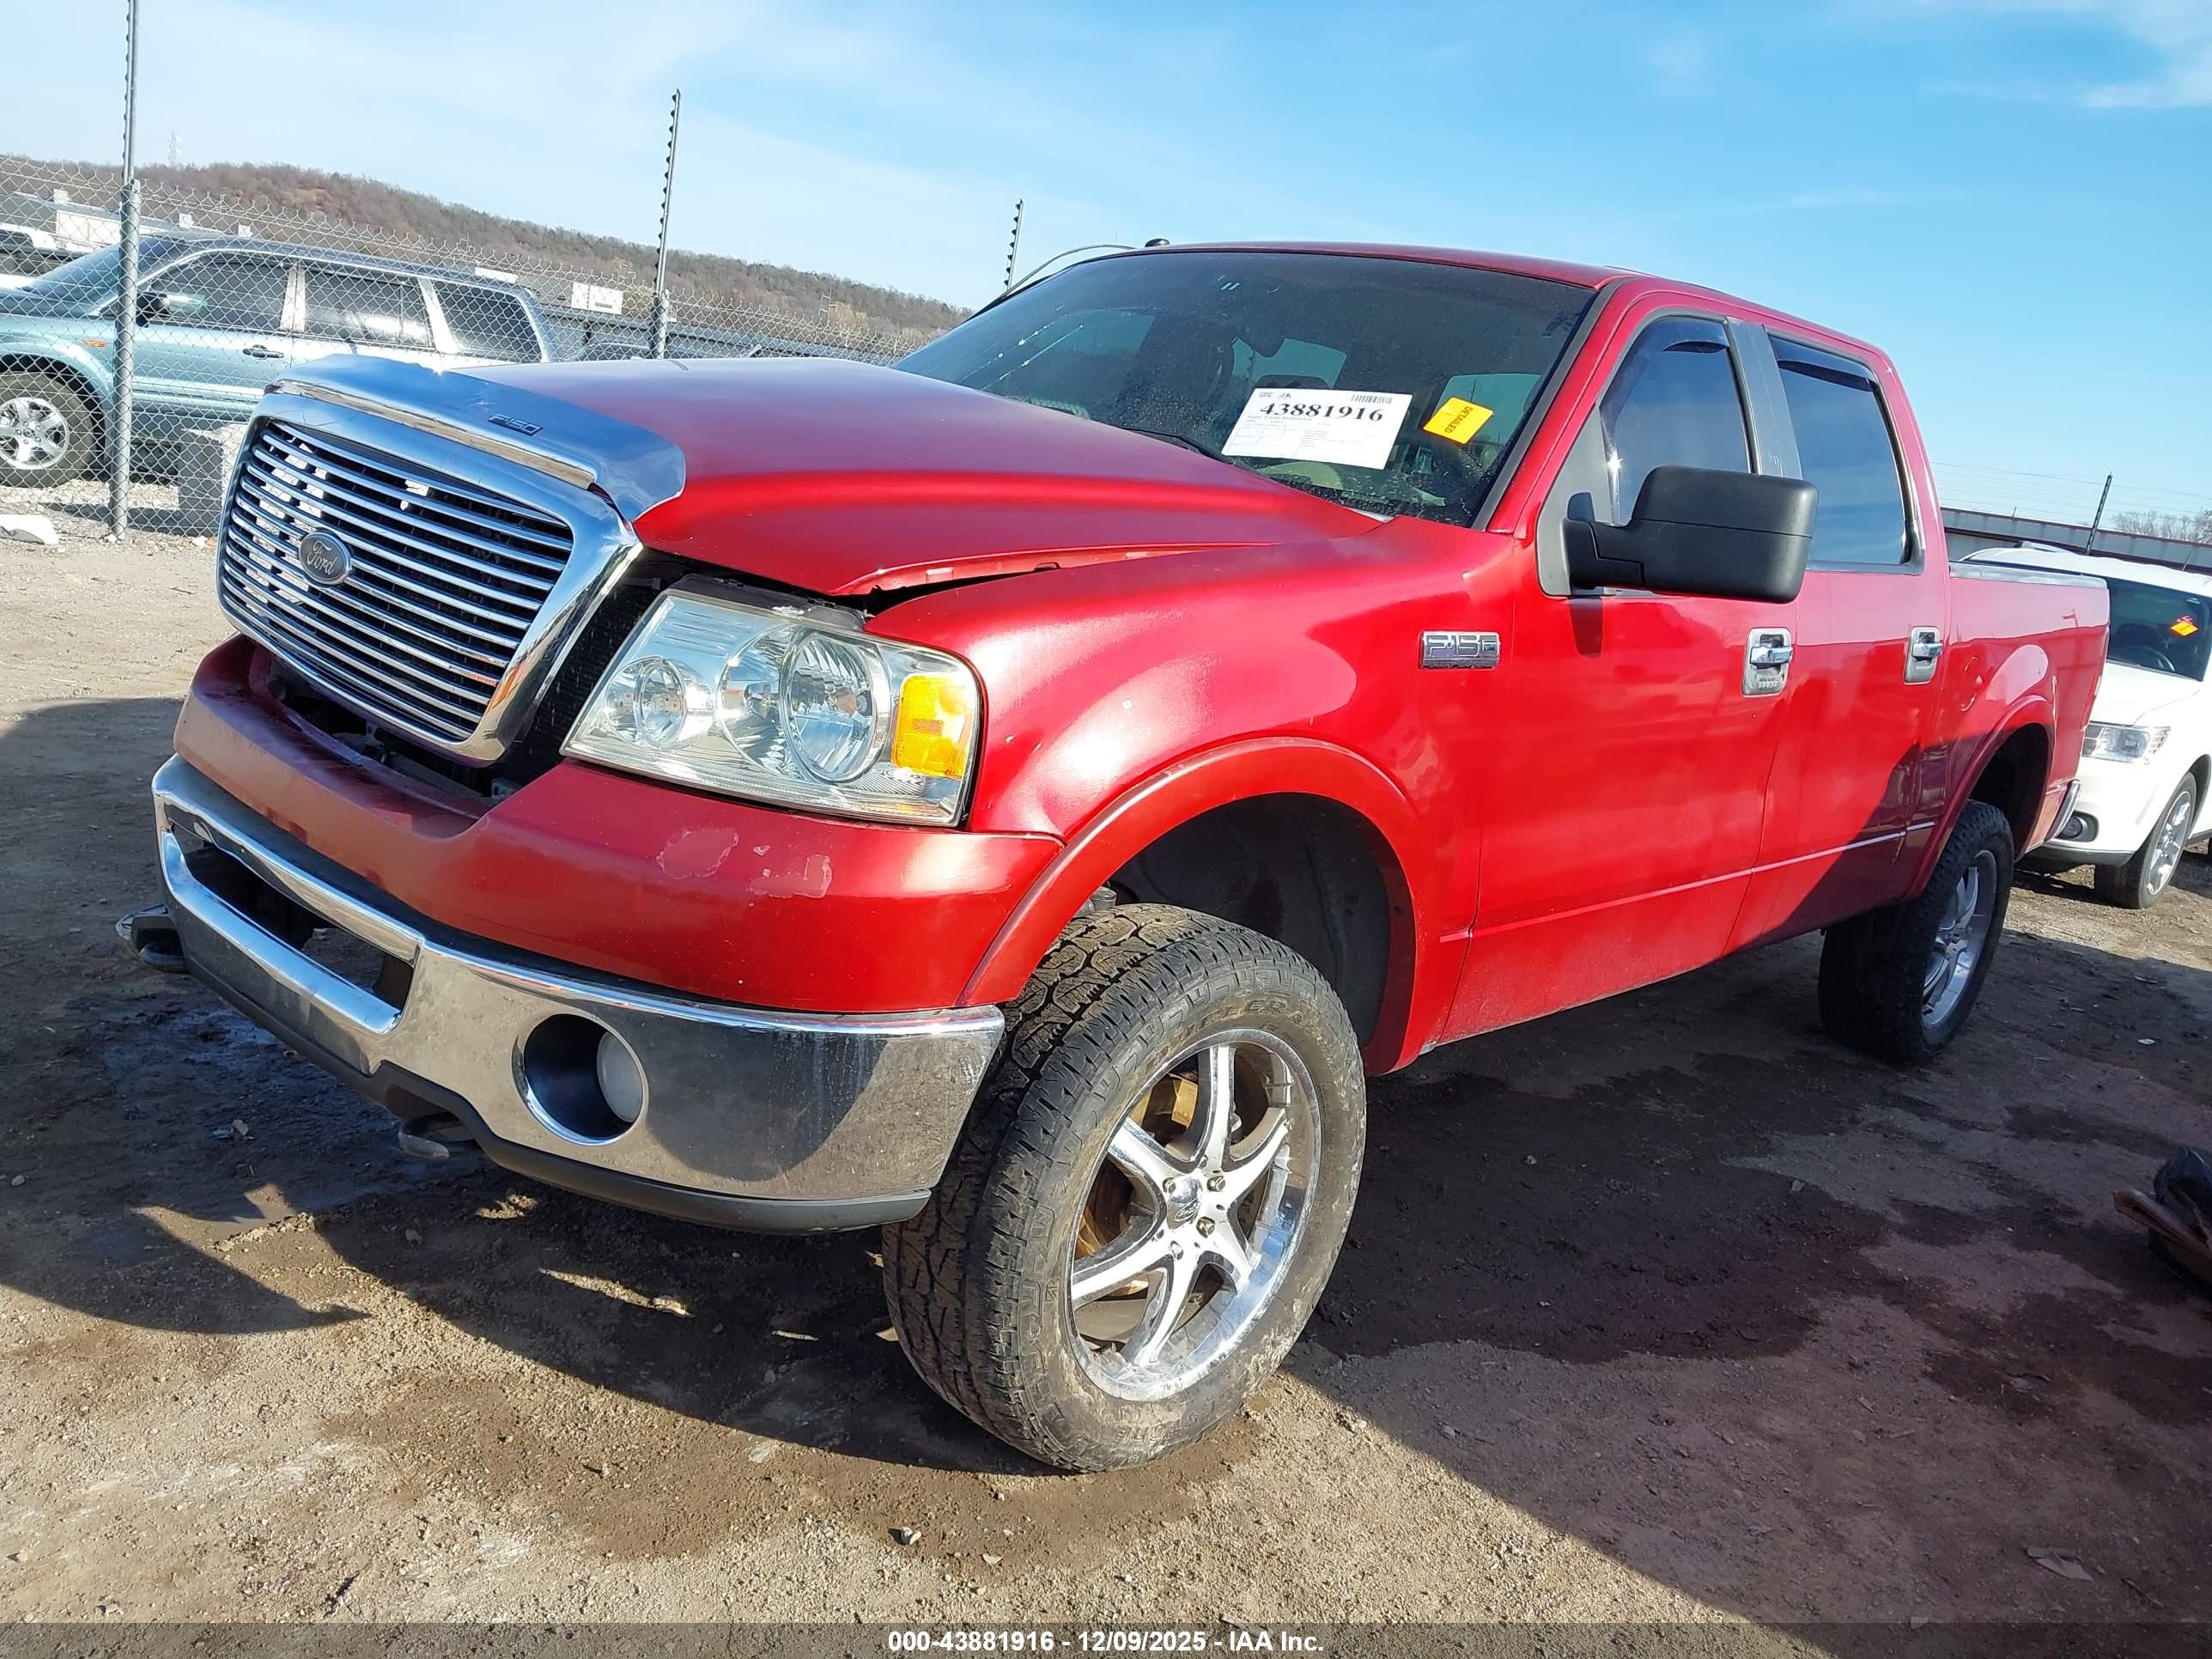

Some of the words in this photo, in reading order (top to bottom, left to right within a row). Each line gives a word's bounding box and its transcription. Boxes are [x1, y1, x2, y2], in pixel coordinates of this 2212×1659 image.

[1260, 403, 1387, 422] 43881916
[1444, 406, 1473, 433] DETAILED
[307, 540, 337, 575] Ford
